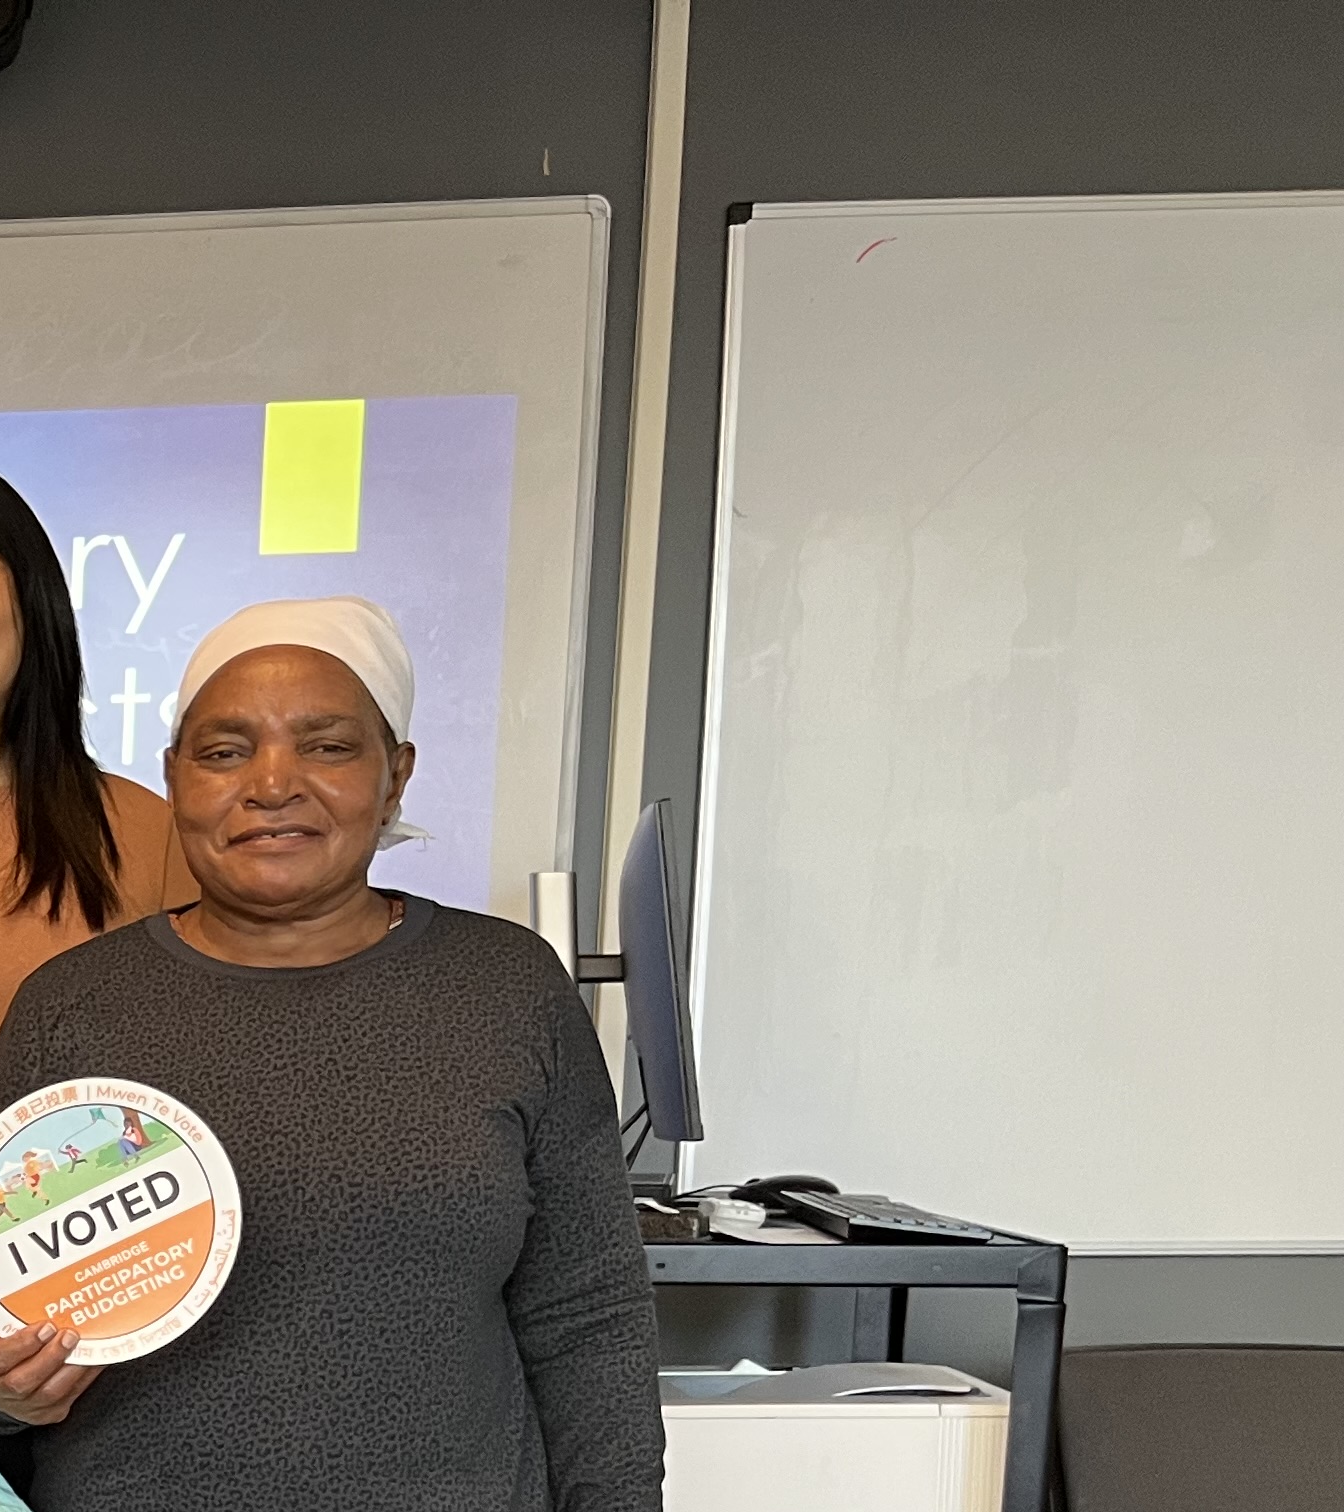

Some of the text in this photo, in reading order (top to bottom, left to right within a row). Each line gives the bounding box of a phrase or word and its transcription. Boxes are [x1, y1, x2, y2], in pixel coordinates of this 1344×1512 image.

[96, 1085, 204, 1143] Mwen Te Vote
[8, 1170, 180, 1275] I VOTED
[44, 1238, 196, 1319] PARTICIPATORY
[74, 1240, 150, 1283] CAMBRIDGE
[70, 1264, 186, 1326] BUDGETING
